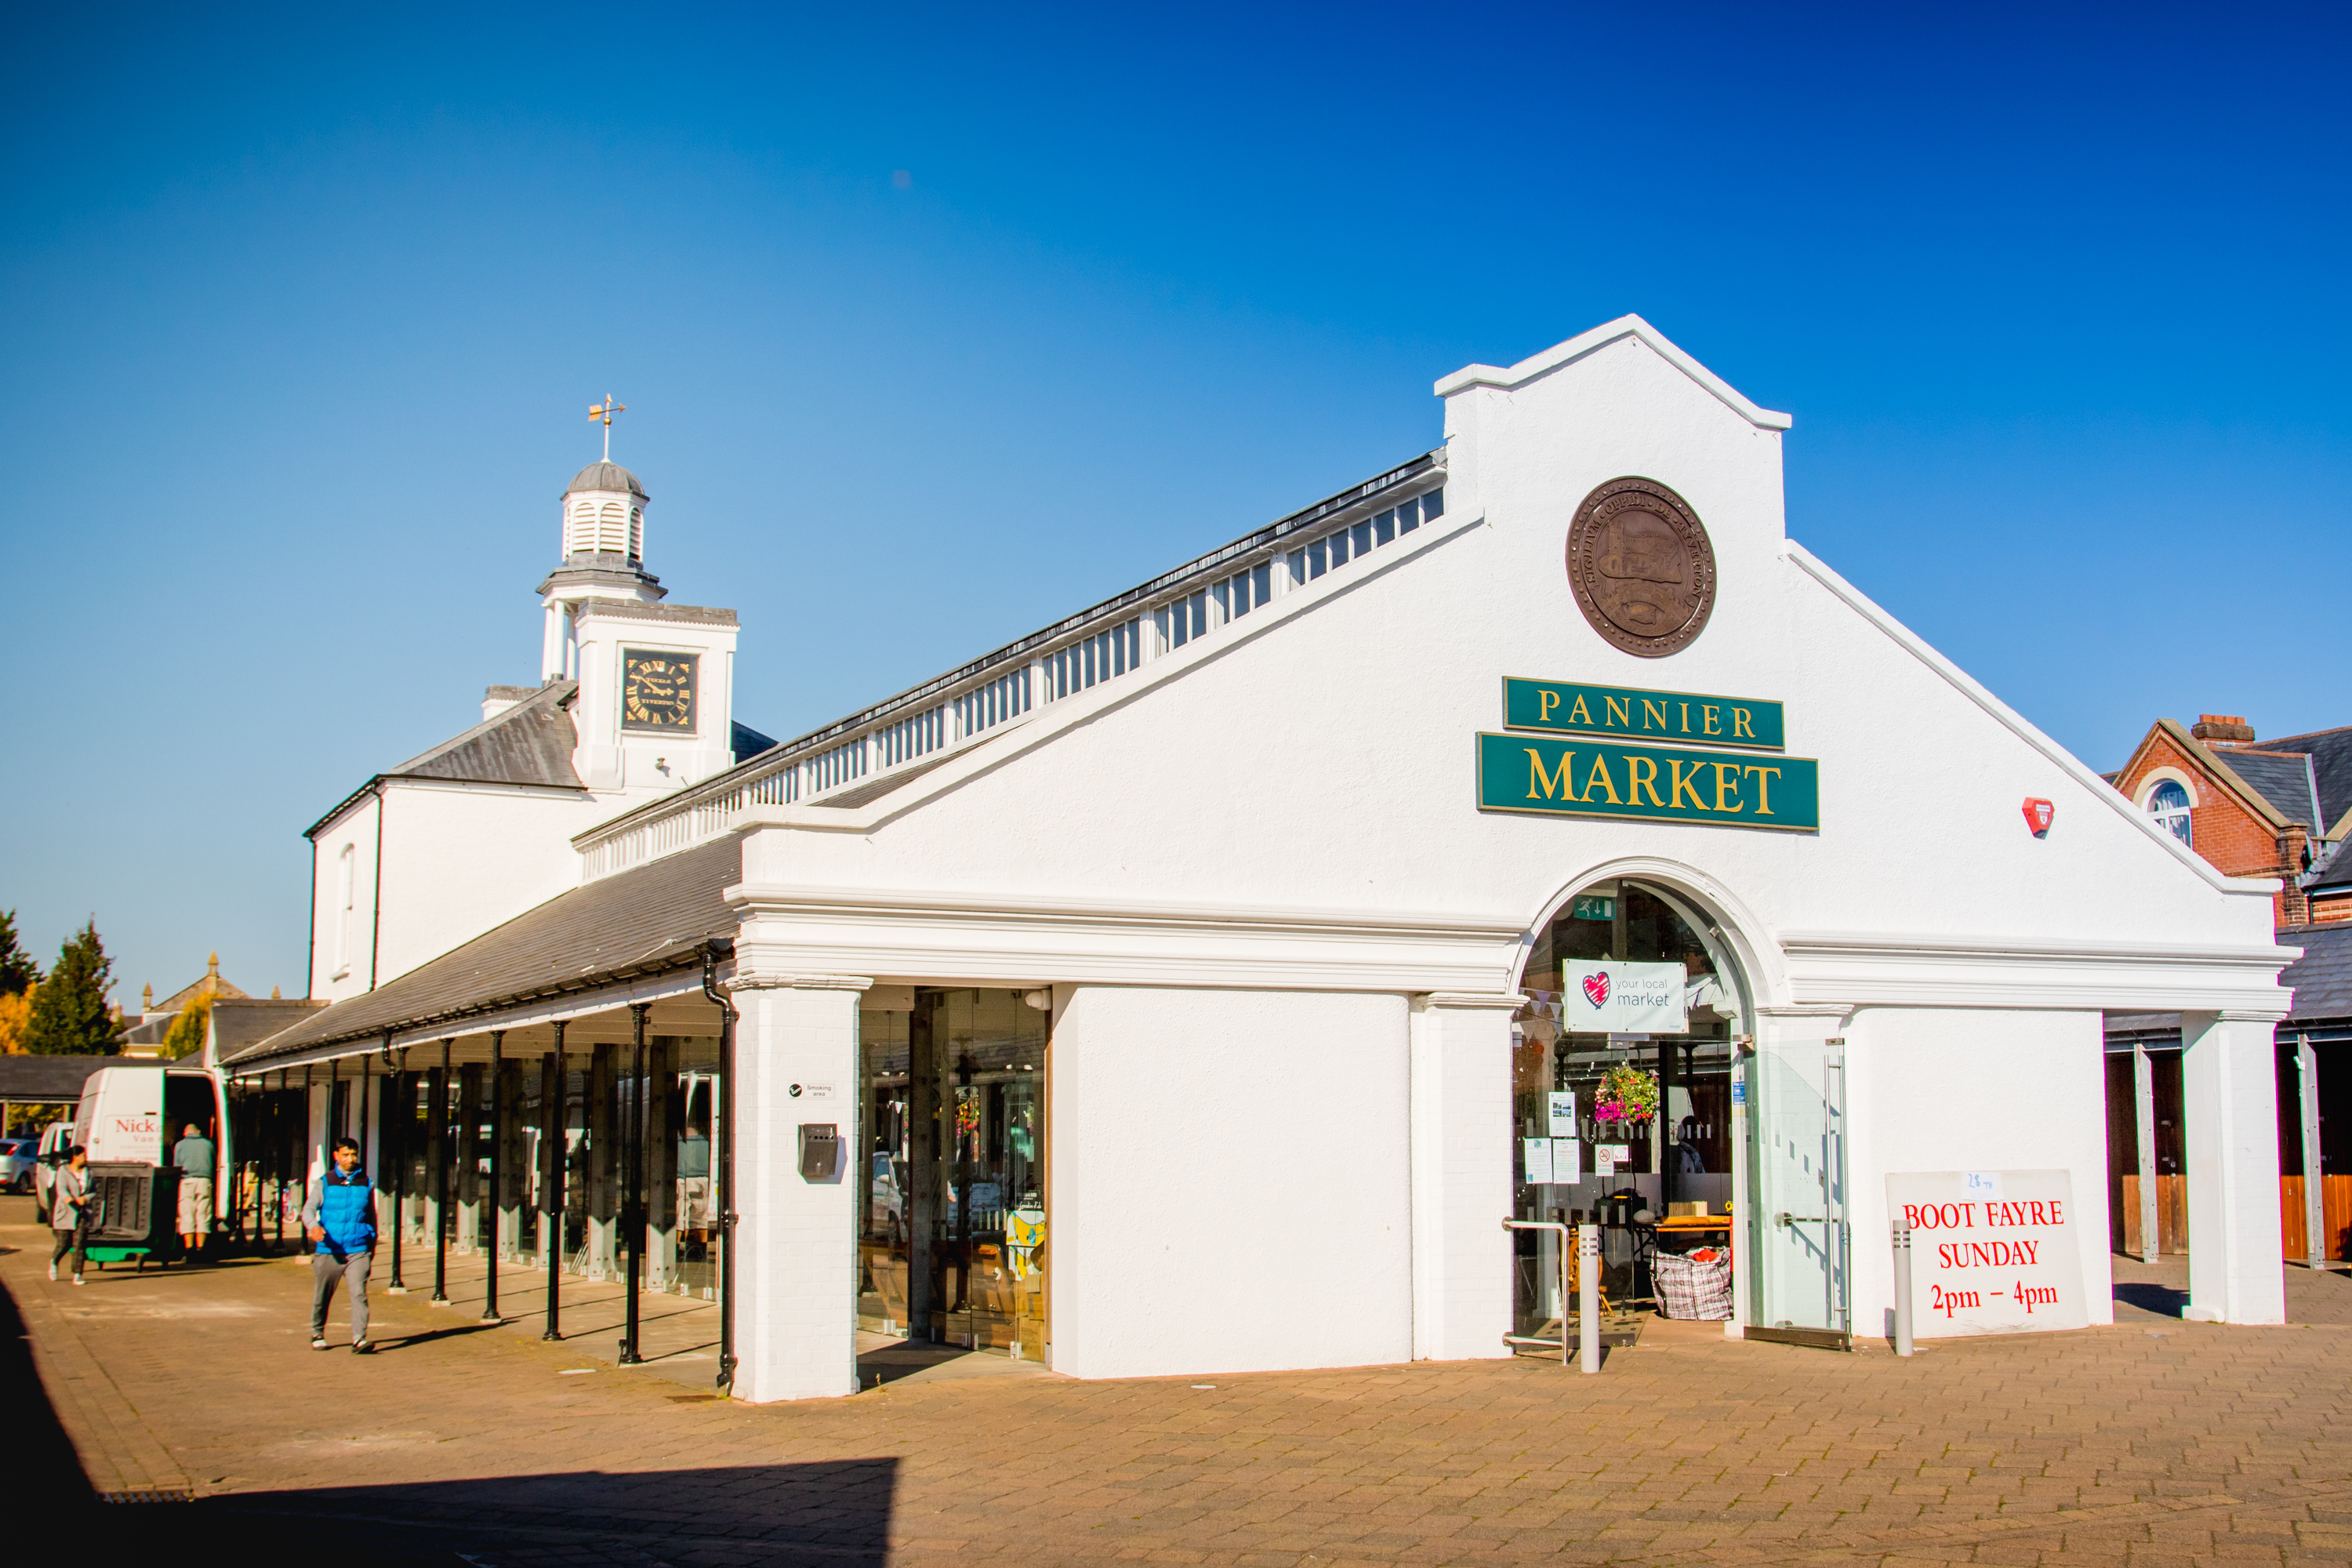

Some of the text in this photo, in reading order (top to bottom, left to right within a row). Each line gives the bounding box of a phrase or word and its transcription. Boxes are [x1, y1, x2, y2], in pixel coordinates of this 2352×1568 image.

[1654, 503, 1671, 518] DE
[1678, 522, 1702, 597] TYVERTON
[1537, 689, 1756, 738] PANNIER
[1523, 748, 1782, 815] MARKET
[1615, 978, 1668, 989] your local
[1617, 992, 1669, 1007] market
[1968, 1173, 1980, 1188] 28
[1902, 1200, 2064, 1229] BOOT FAYRE
[1938, 1240, 2039, 1269] SUNDAY
[1931, 1284, 1981, 1318] 2pm
[2013, 1279, 2059, 1314] 4pm
